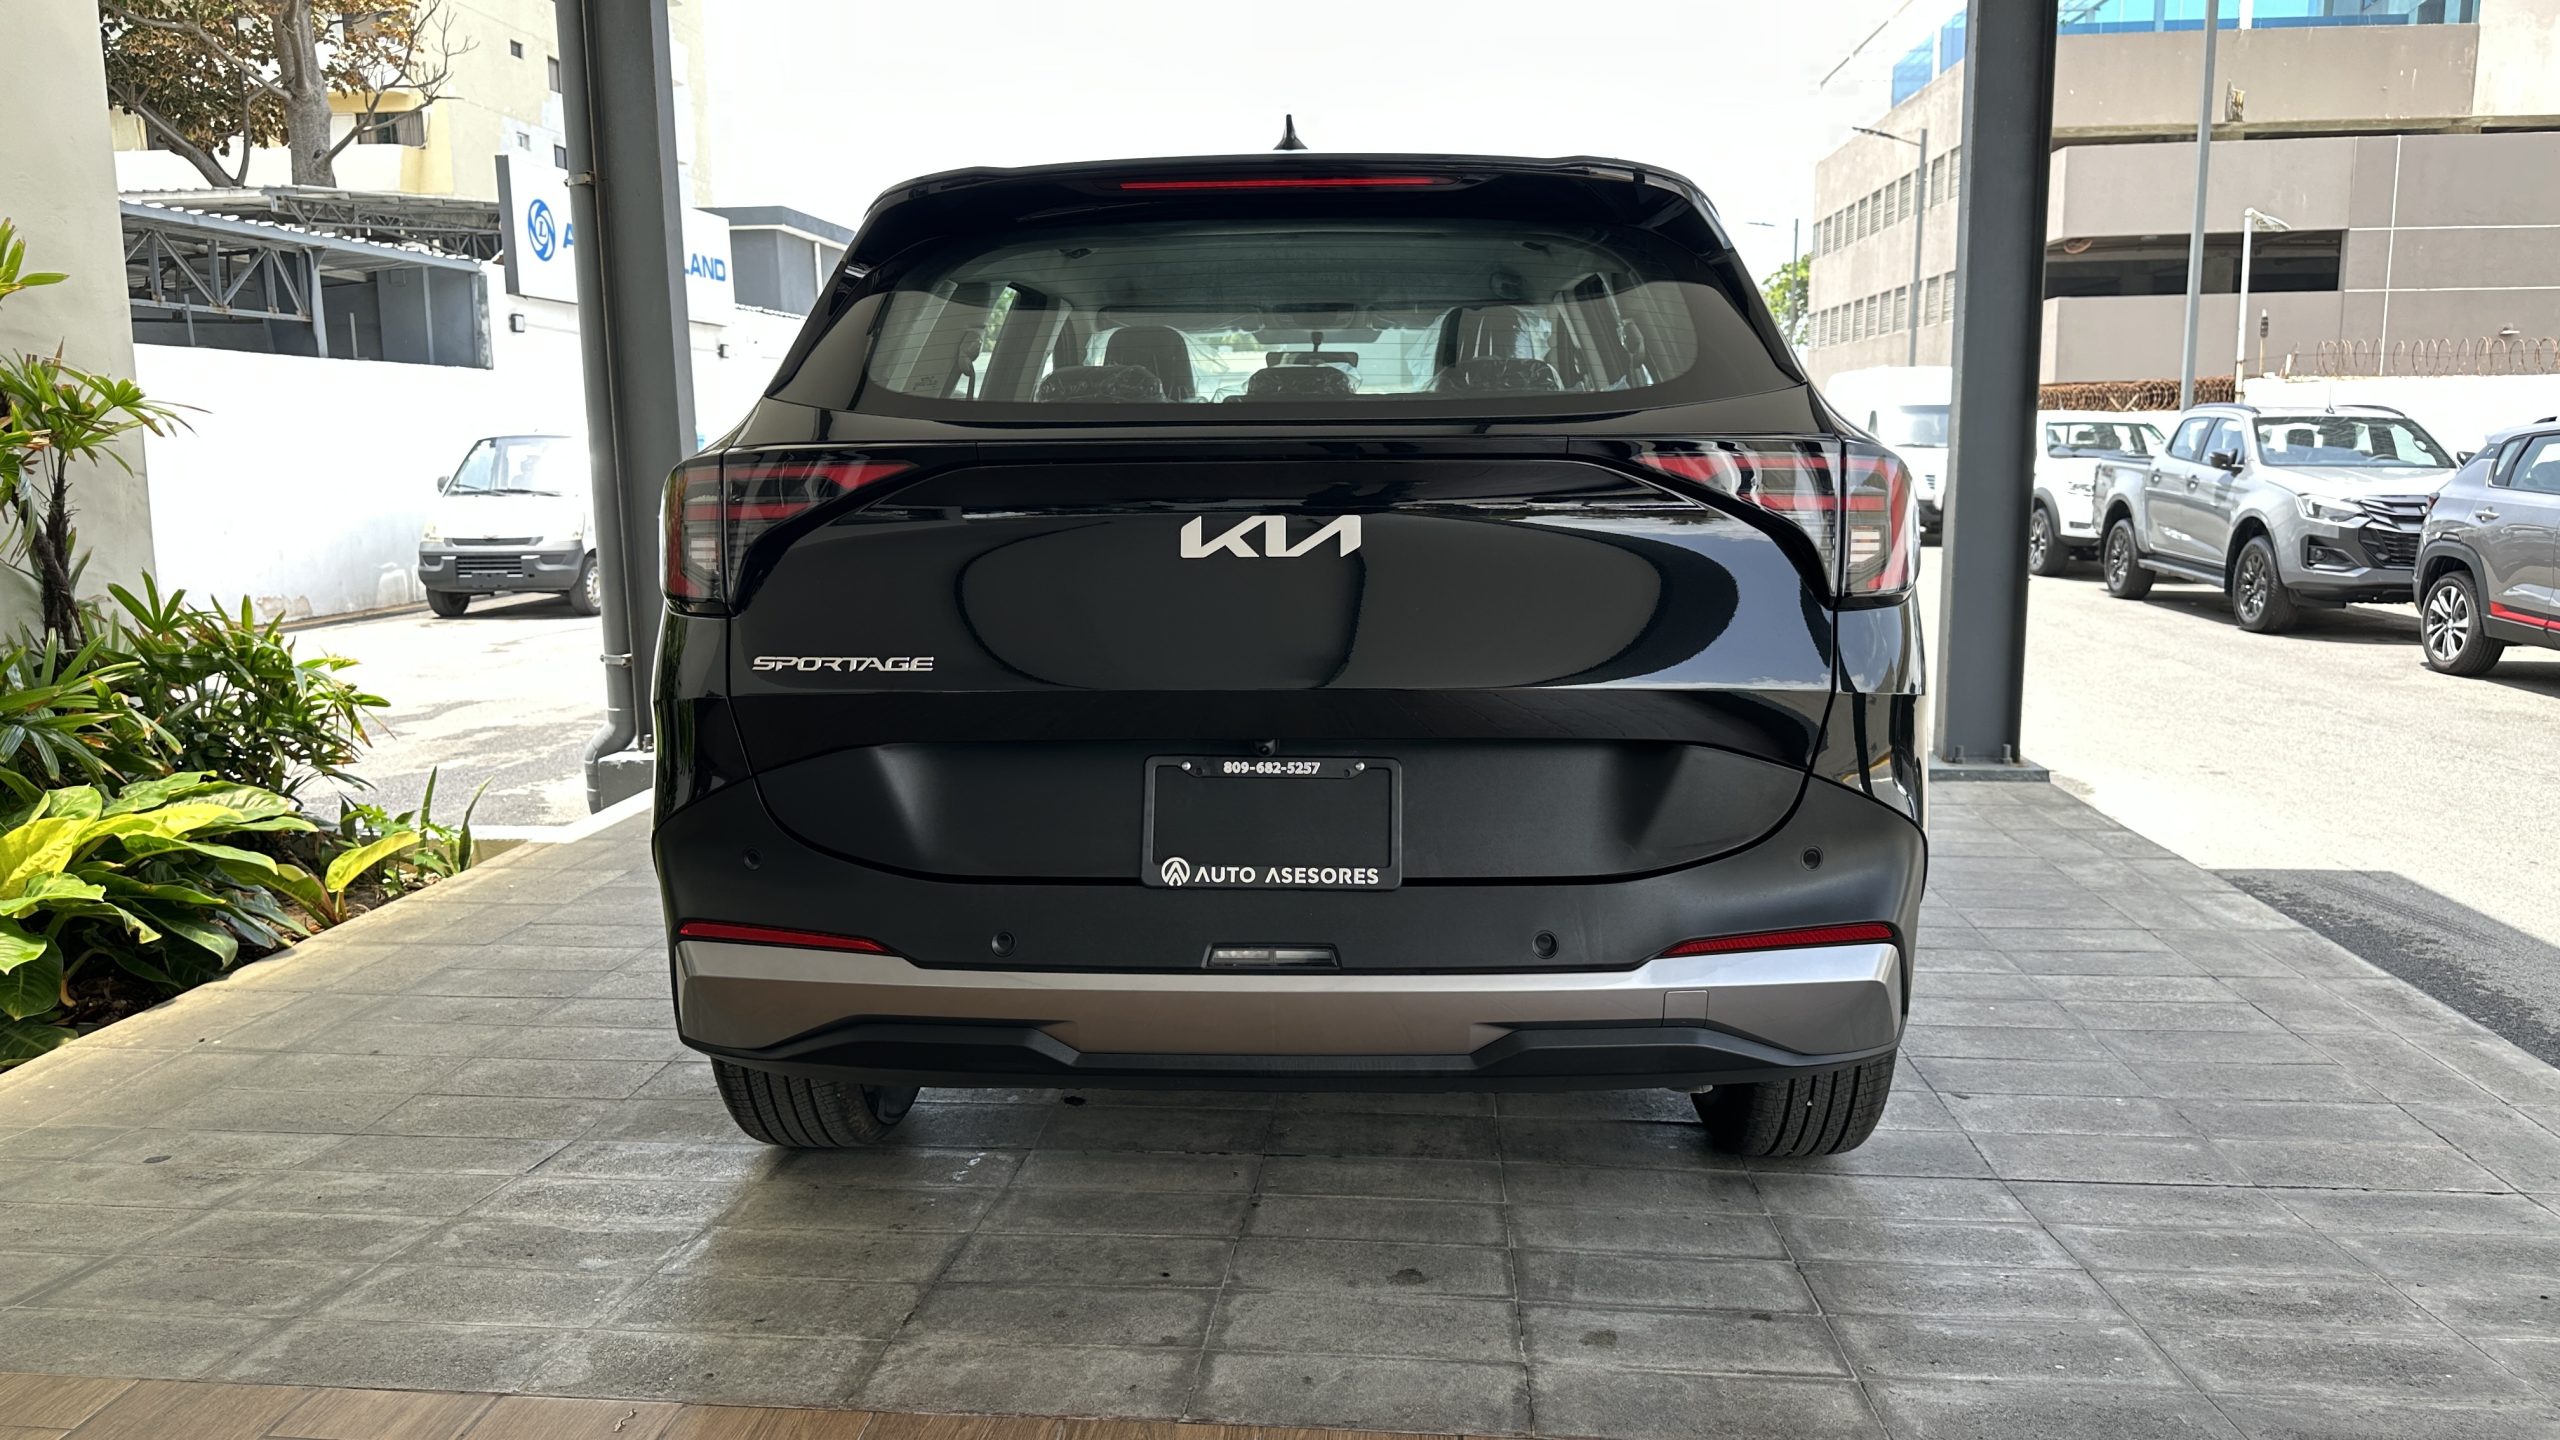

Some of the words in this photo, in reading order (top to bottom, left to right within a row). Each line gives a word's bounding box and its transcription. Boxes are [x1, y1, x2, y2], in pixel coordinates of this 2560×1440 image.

[684, 253, 726, 282] AND
[1180, 514, 1362, 559] KIA
[752, 656, 935, 673] SPORTAGE
[1223, 761, 1321, 775] 809-682-5257
[1194, 866, 1256, 884] AUTO
[1264, 867, 1379, 885] ASESORES
